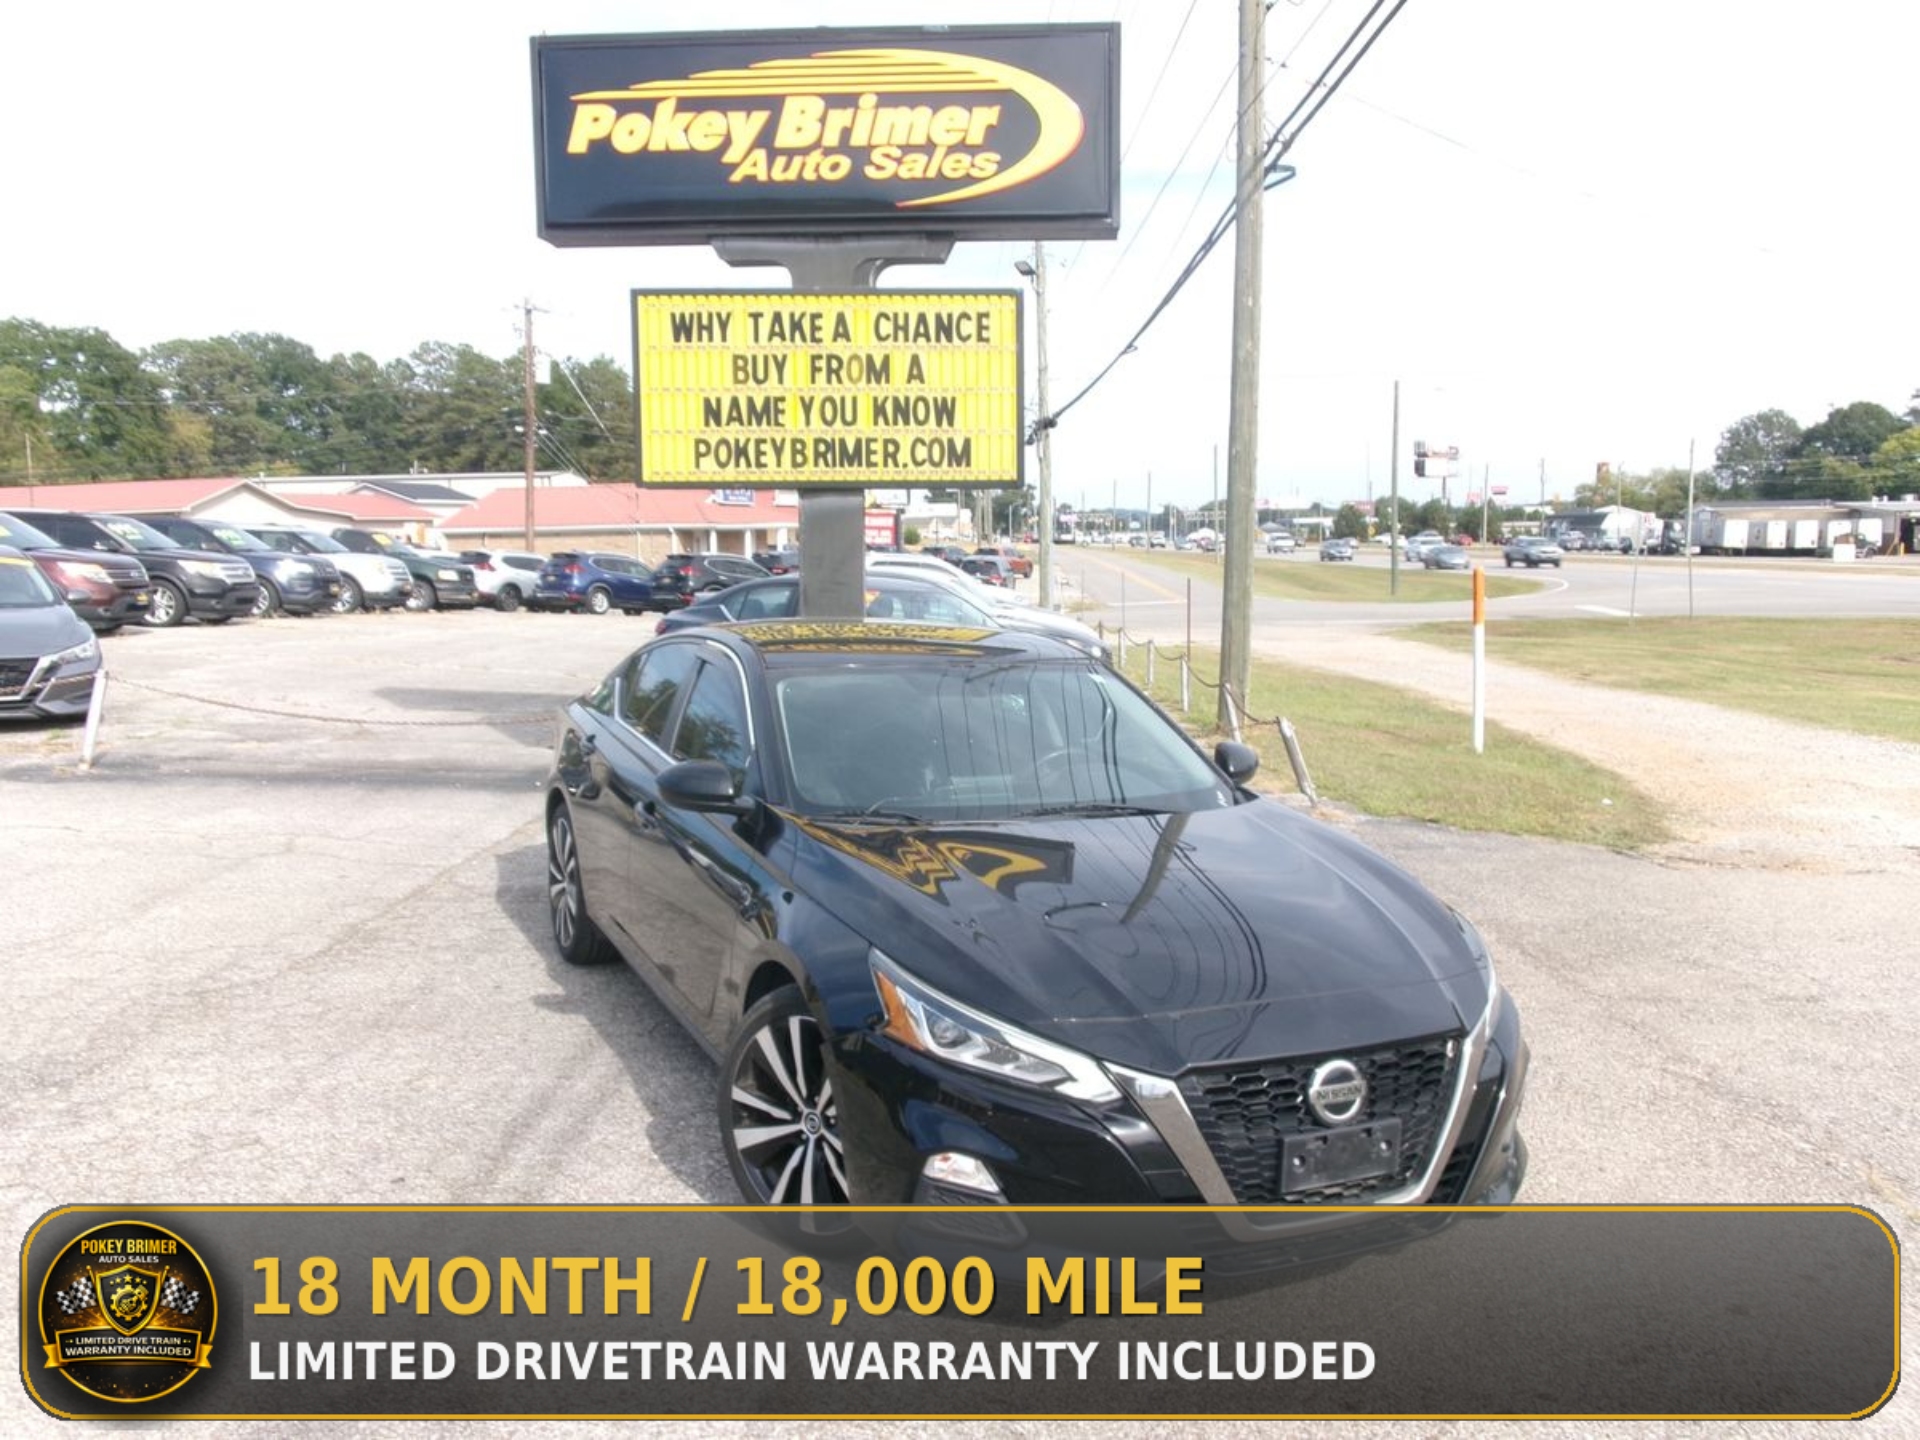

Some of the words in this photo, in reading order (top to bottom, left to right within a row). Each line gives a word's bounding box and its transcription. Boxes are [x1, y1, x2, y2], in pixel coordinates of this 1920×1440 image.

[566, 96, 772, 164] Pokey
[773, 92, 1001, 149] Brimer
[728, 147, 852, 182] Auto
[863, 145, 1001, 180] Sales
[670, 312, 732, 343] WHY
[748, 312, 823, 344] TAKE
[832, 312, 851, 343] A
[874, 312, 990, 343] CHANCE
[733, 354, 787, 385] BUY
[810, 353, 890, 385] FROM
[906, 354, 925, 384] A
[703, 396, 786, 428] NAME
[801, 396, 858, 428] YOU
[873, 395, 956, 428] KNOW
[694, 438, 972, 469] POKEYBRIMER.COM
[1316, 1085, 1361, 1101] NISSAN
